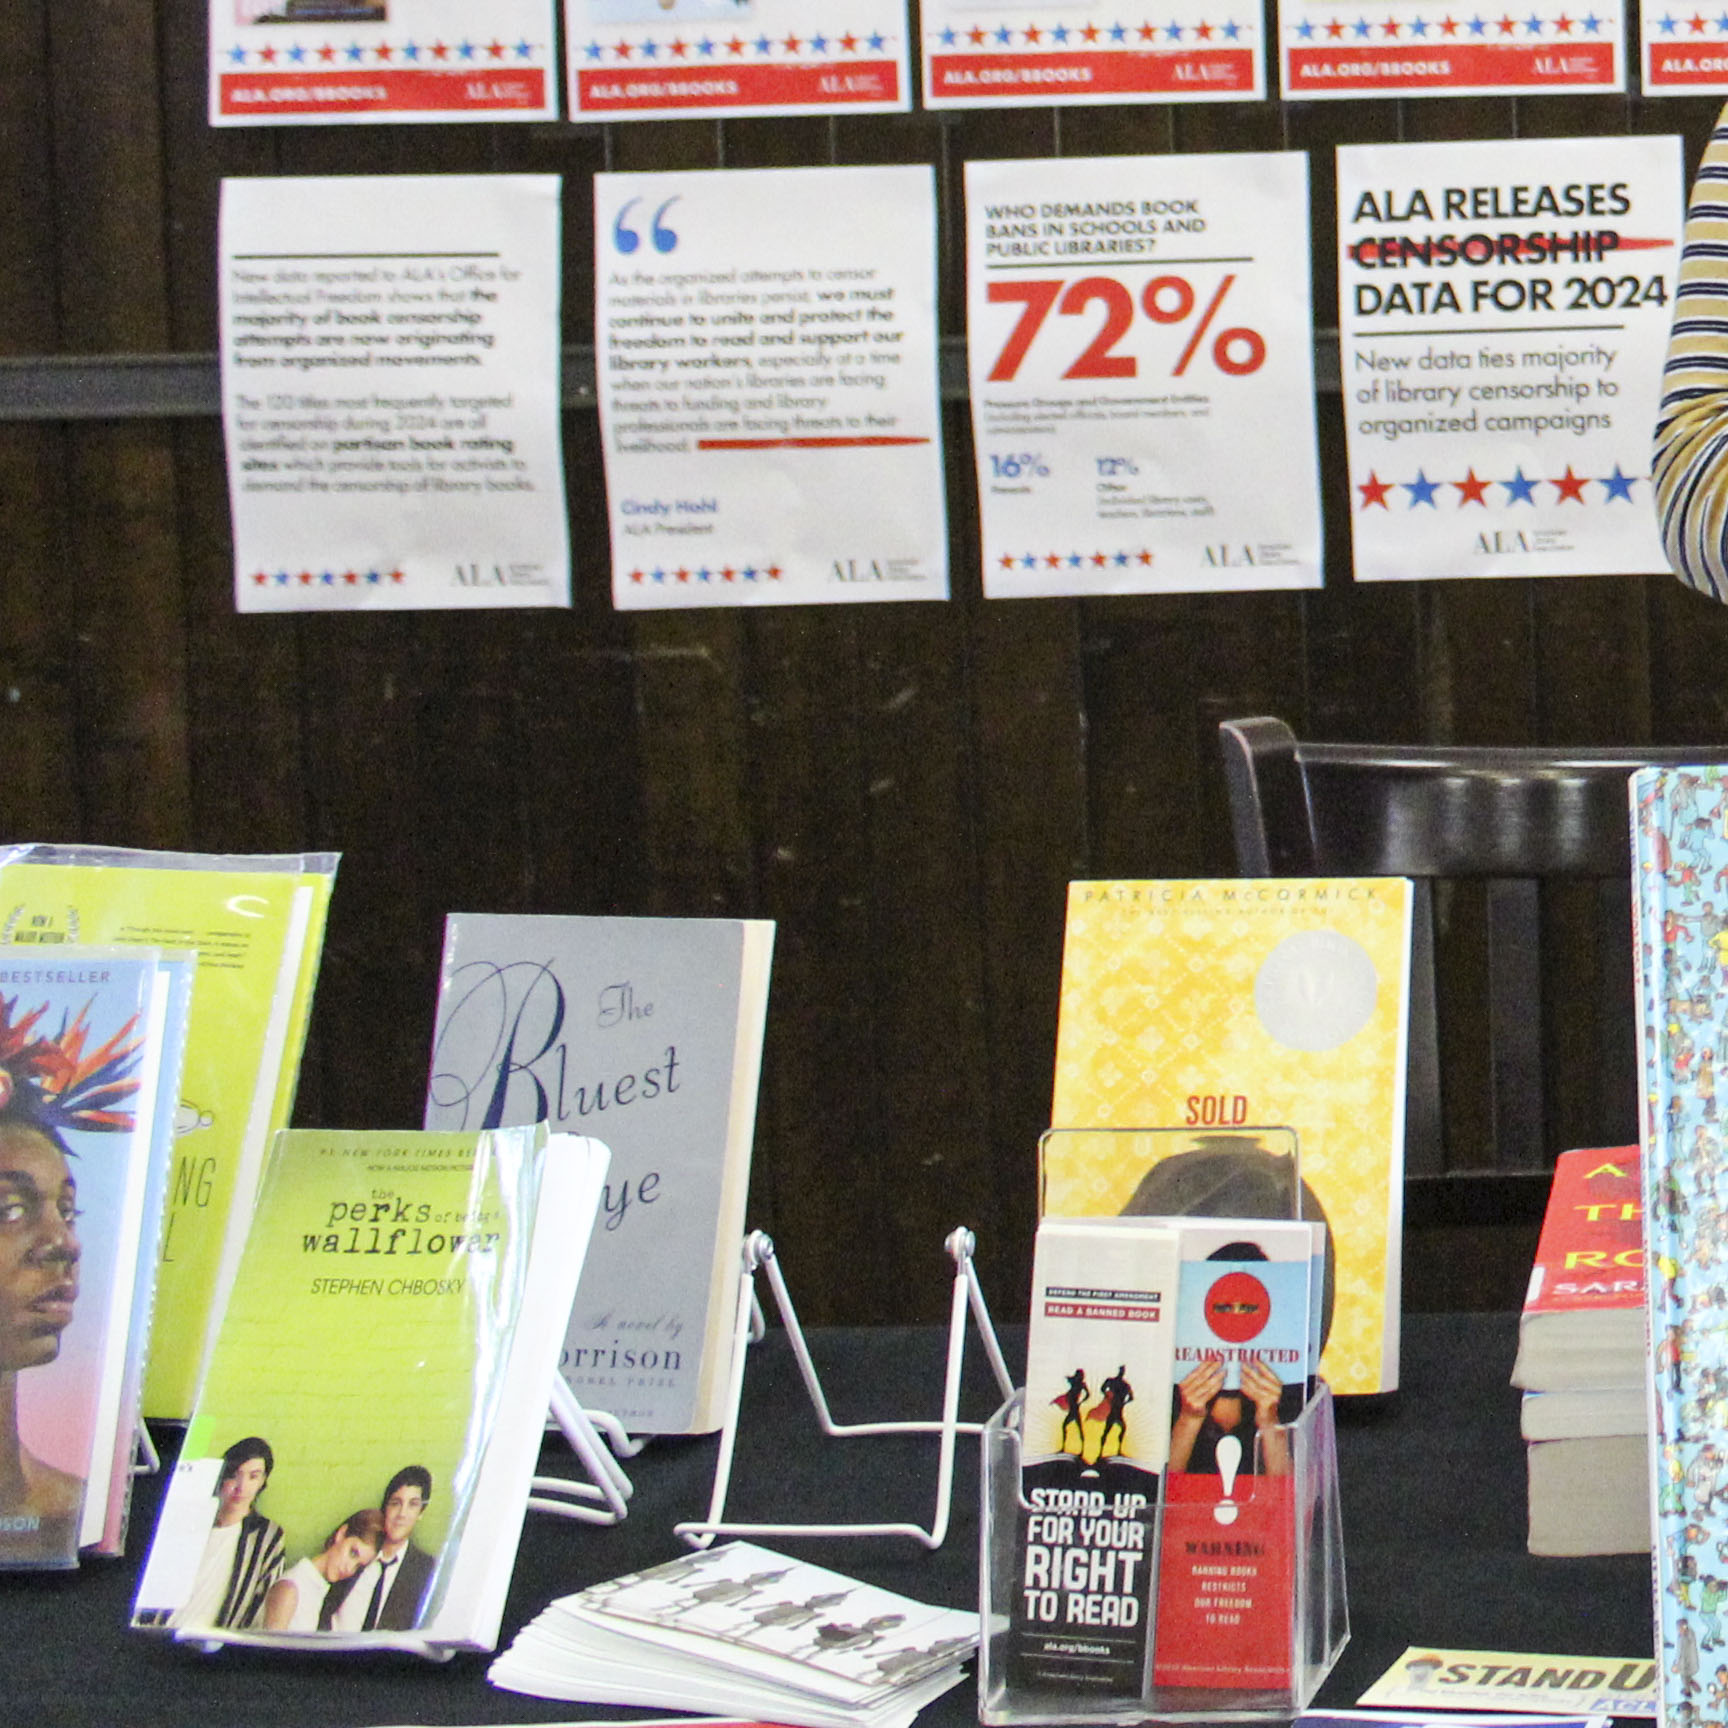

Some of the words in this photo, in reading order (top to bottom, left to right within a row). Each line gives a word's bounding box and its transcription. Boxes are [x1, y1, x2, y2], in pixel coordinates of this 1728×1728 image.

[986, 203, 1035, 220] WHO
[1040, 201, 1136, 218] DEMANDS
[1141, 199, 1198, 214] BOOK
[1352, 189, 1433, 223] ALA
[1444, 183, 1631, 221] RELEASES
[986, 223, 1038, 238] BANS
[1043, 222, 1064, 236] IN
[1069, 220, 1157, 236] SCHOOLS
[1162, 219, 1206, 233] AND
[986, 241, 1050, 257] PUBLIC
[1054, 239, 1156, 255] LIBRARIES?
[1352, 230, 1620, 270] CENSORSHIP
[1355, 281, 1461, 316] DATA
[1471, 279, 1554, 313] FOR
[1564, 275, 1669, 310] 2024
[986, 274, 1267, 382] 72%
[1355, 350, 1411, 372] New
[1418, 347, 1472, 370] data
[1478, 346, 1515, 367] ties
[1521, 345, 1616, 373] majority
[1357, 381, 1381, 404] of
[1386, 380, 1461, 406] library
[1468, 376, 1591, 403] censorship
[1597, 376, 1619, 397] to
[1358, 410, 1478, 440] organized
[1484, 412, 1612, 438] campaigns
[1085, 888, 1204, 902] PATRICIA
[1221, 888, 1377, 902] McCORMICK
[599, 980, 655, 1028] The
[428, 957, 681, 1131] Bluest
[1186, 1095, 1248, 1125] SOLD
[326, 1197, 431, 1227] perks
[303, 1228, 500, 1255] wallflower
[311, 1279, 384, 1295] STEPHEN
[388, 1279, 465, 1296] CHBOSKY
[1047, 1304, 1074, 1316] READ
[1076, 1306, 1084, 1316] A
[1086, 1307, 1125, 1319] BANNED
[1128, 1309, 1156, 1321] BOOK
[1031, 1487, 1110, 1515] STAND
[1114, 1494, 1147, 1519] UP
[1028, 1516, 1078, 1545] FOR
[1081, 1520, 1145, 1549] YOUR
[1024, 1546, 1143, 1595] RIGHT
[1024, 1591, 1062, 1622] TO
[1067, 1592, 1139, 1628] READ
